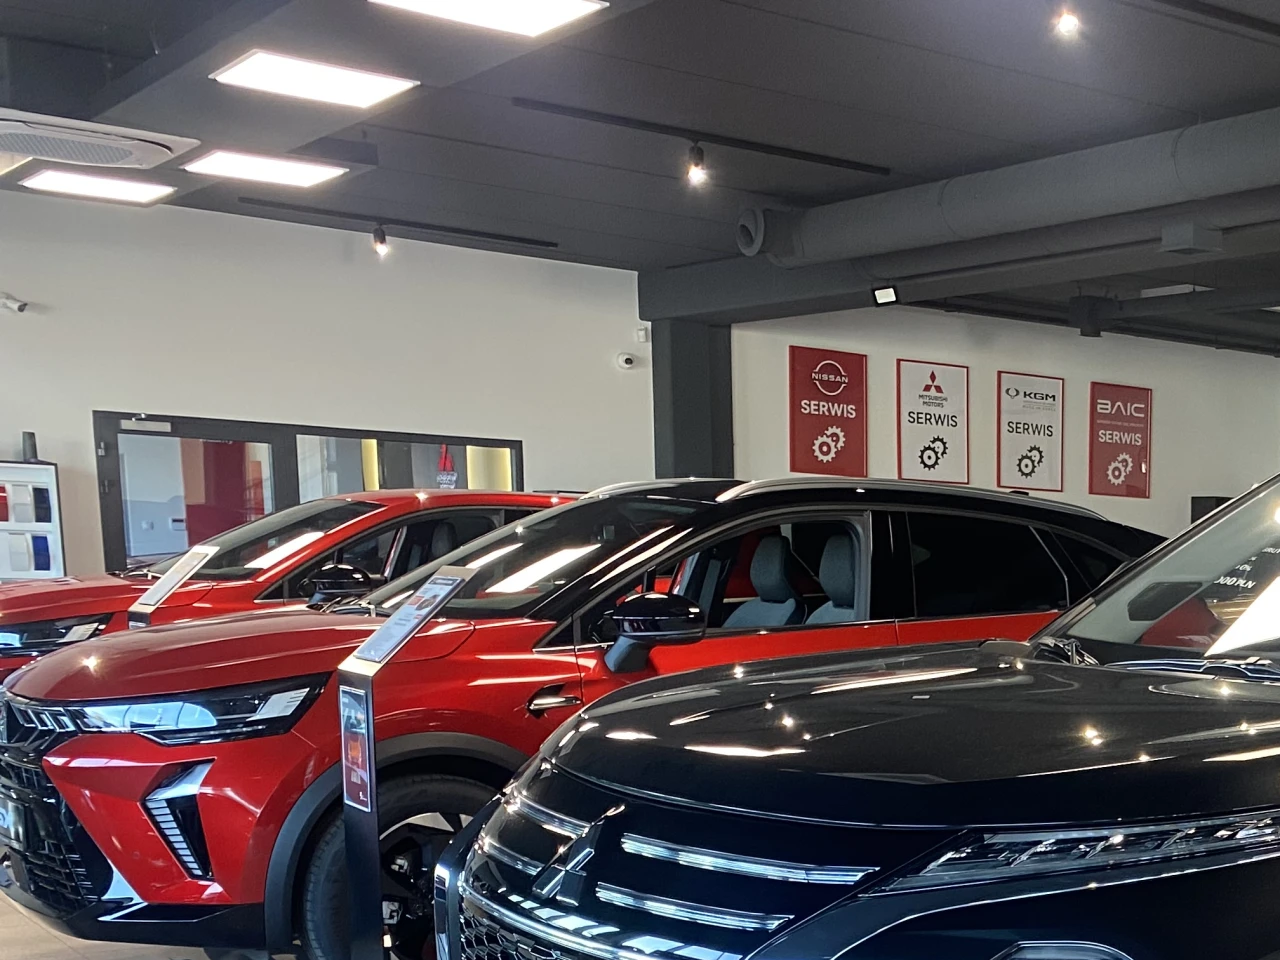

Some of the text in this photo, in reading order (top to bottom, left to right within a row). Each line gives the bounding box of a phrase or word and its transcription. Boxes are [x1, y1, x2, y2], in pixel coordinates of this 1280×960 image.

[812, 372, 848, 383] NISSAN
[918, 394, 949, 402] MITSUBISHI
[1023, 391, 1056, 402] KGM
[801, 399, 856, 419] SERWIS
[1097, 399, 1145, 418] BAIC
[907, 411, 958, 428] SERWIS
[1007, 421, 1053, 437] SERWIS
[1098, 430, 1142, 446] SERWIS
